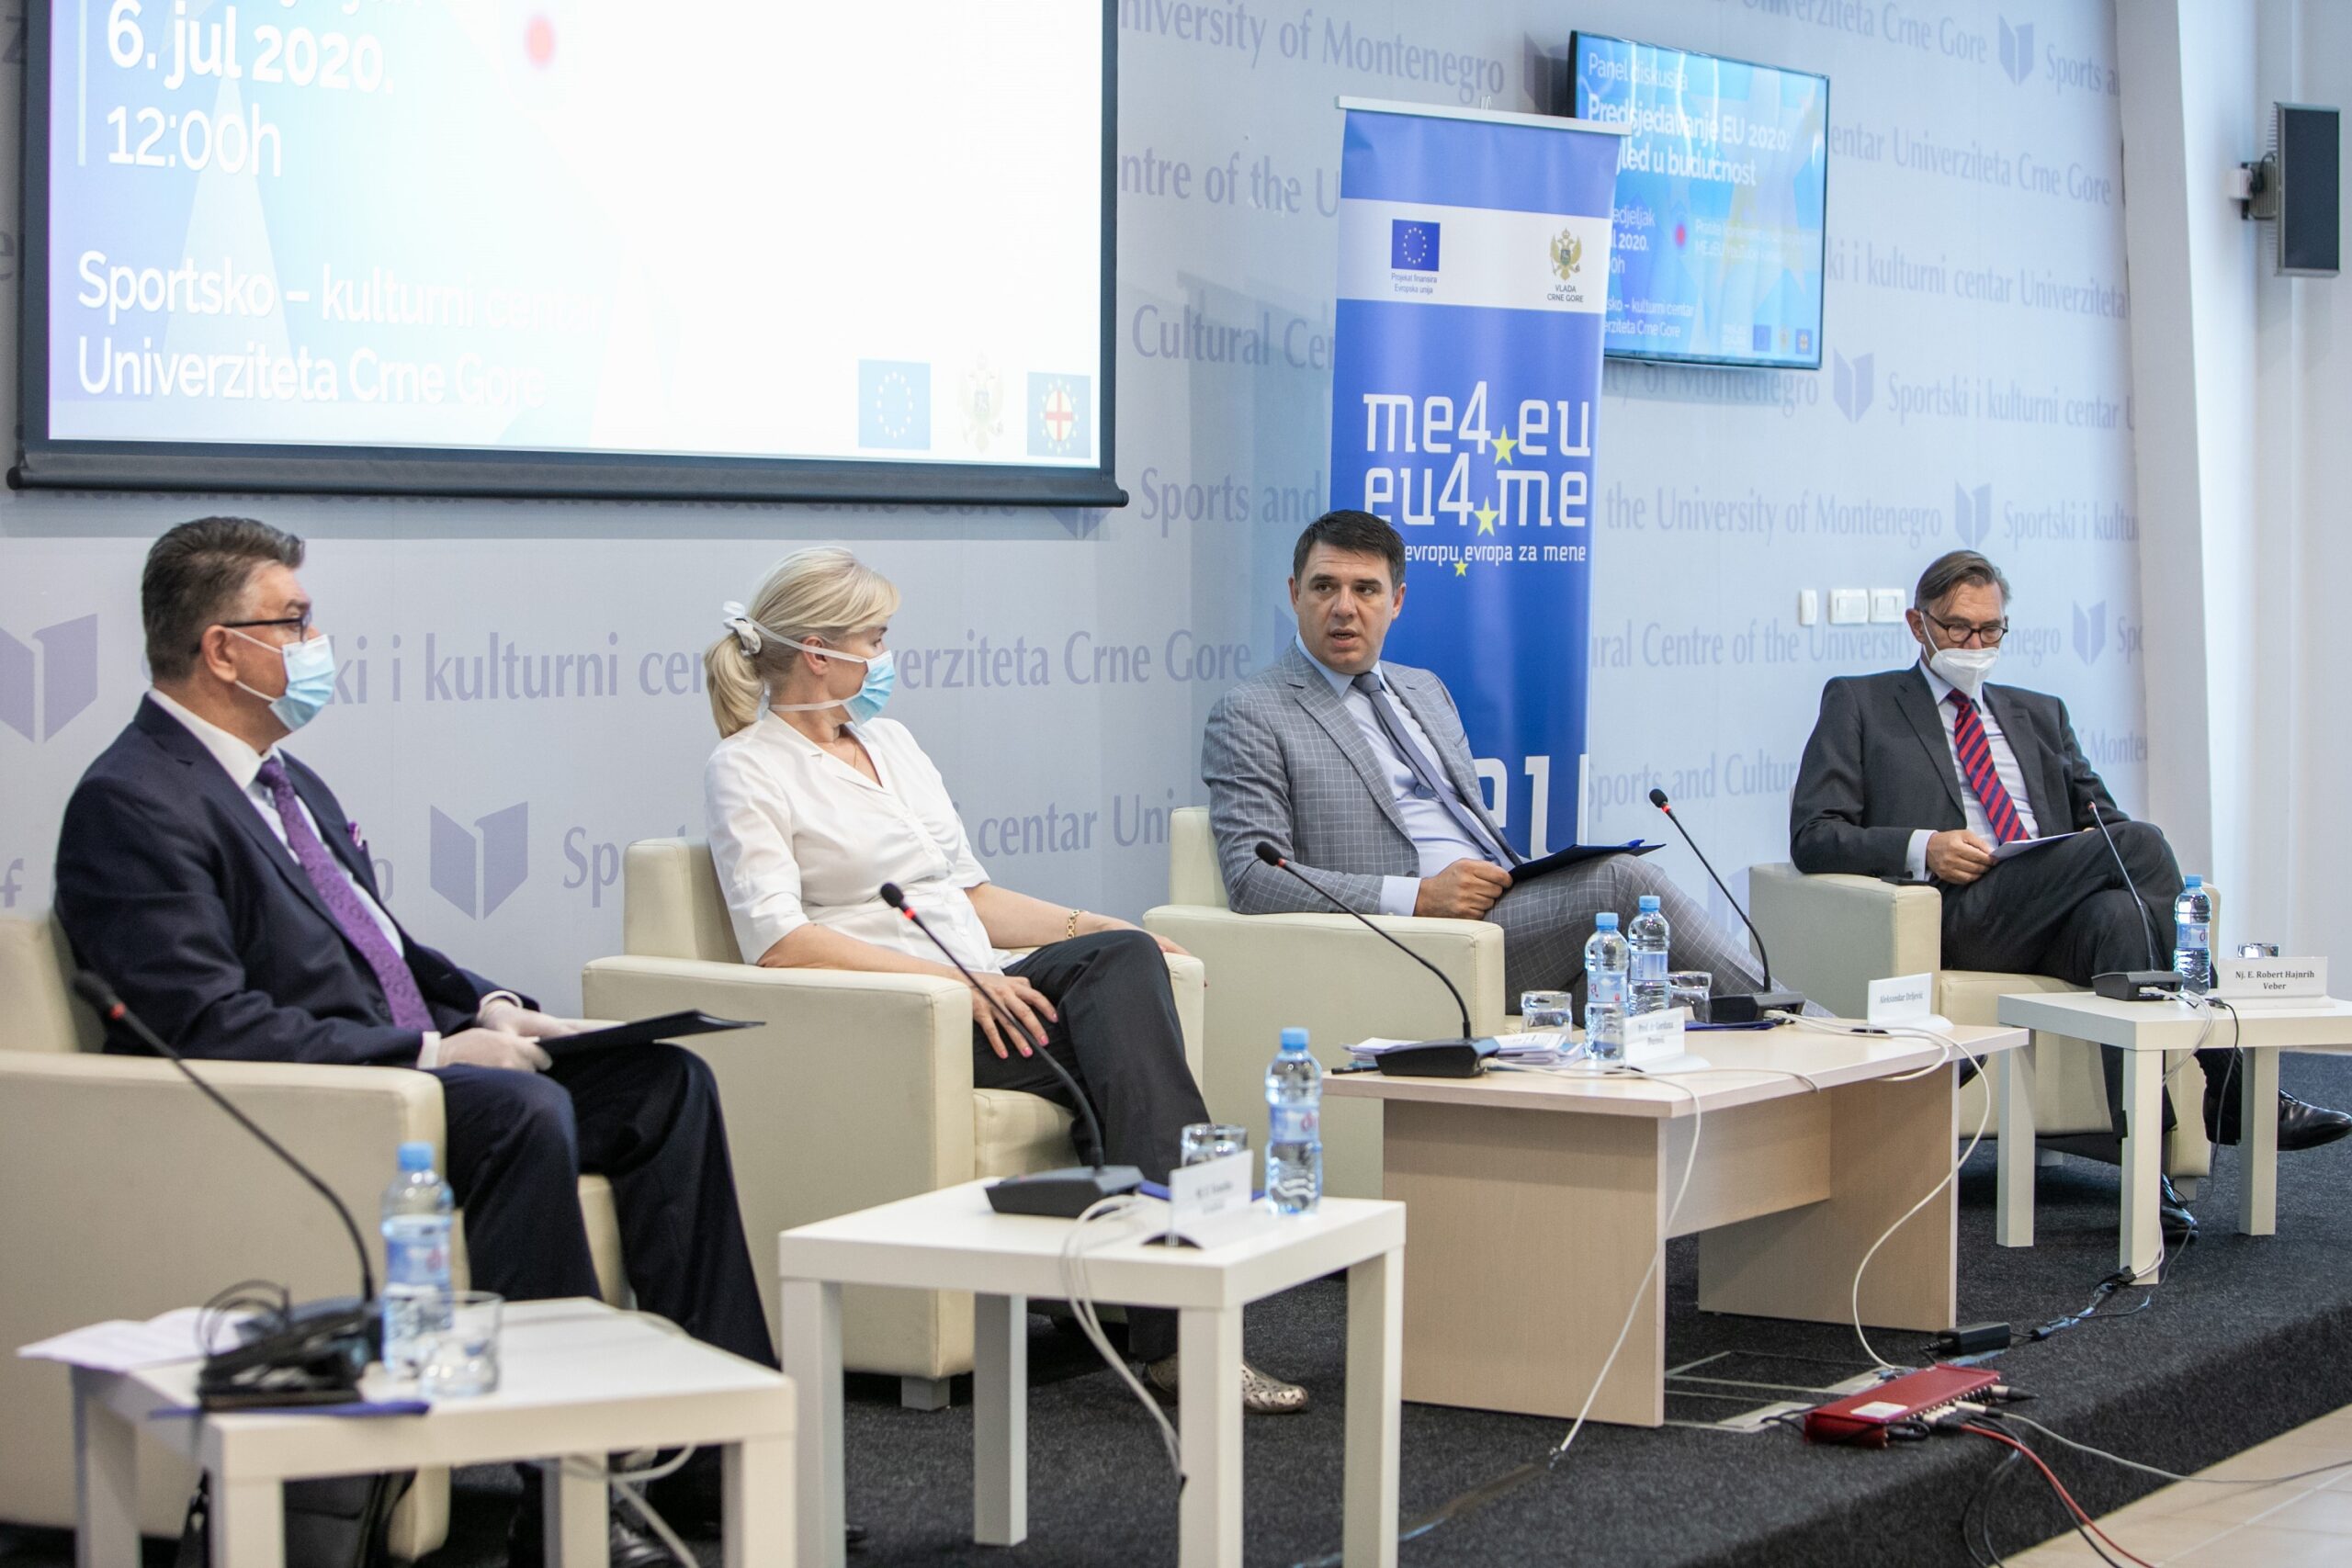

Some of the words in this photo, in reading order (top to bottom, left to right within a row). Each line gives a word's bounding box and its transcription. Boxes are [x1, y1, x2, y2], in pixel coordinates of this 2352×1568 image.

[107, 1, 156, 69] 6.
[164, 1, 242, 89] jul
[252, 25, 394, 94] 2020.
[1280, 8, 1313, 61] of
[1322, 17, 1504, 105] Montenegro
[1883, 4, 1930, 51] Crne
[1939, 17, 1987, 63] Gore
[1589, 52, 1629, 81] Panel
[2046, 42, 2101, 96] Sports
[107, 103, 282, 177] 12:00h
[1724, 115, 1746, 143] EU
[1204, 151, 1240, 205] of
[1250, 154, 1302, 213] the
[1894, 126, 2011, 186] Univerziteta
[2018, 152, 2061, 196] Crne
[2067, 163, 2111, 206] Gore
[1618, 232, 1649, 251] 2020.
[78, 251, 275, 324] Sportsko
[322, 264, 475, 327] kulturni
[1547, 293, 1566, 302] CRNE
[1566, 294, 1584, 303] GORE
[1555, 284, 1577, 293] VLADA
[1867, 242, 1946, 294] kulturni
[1954, 266, 2013, 304] centar
[2020, 268, 2127, 319] Univerziteta
[1132, 304, 1270, 366] Cultural
[79, 335, 338, 402] Univerziteta
[349, 346, 444, 404] Crne
[455, 351, 548, 408] Gore
[1888, 371, 1968, 427] Sportski
[1987, 378, 2059, 424] kulturni
[2065, 395, 2120, 430] centar
[1140, 467, 1250, 538] Sports
[1262, 469, 1321, 524] and
[1606, 480, 1646, 531] the
[1657, 485, 1778, 547] University
[1785, 489, 1809, 535] of
[1815, 493, 1942, 550] Montenegro
[2004, 500, 2075, 552] Sportski
[1519, 546, 1537, 562] za
[1544, 545, 1586, 562] mene
[392, 634, 401, 702] i
[425, 632, 618, 701] kulturni
[1064, 630, 1150, 685] Crne
[1165, 628, 1251, 682] Gore
[1642, 622, 1724, 668] Centre
[1732, 619, 1756, 665] of
[1764, 617, 1800, 663] the
[1672, 751, 1715, 802] and
[978, 802, 1098, 858] centar
[2285, 971, 2314, 980] Hajnrih
